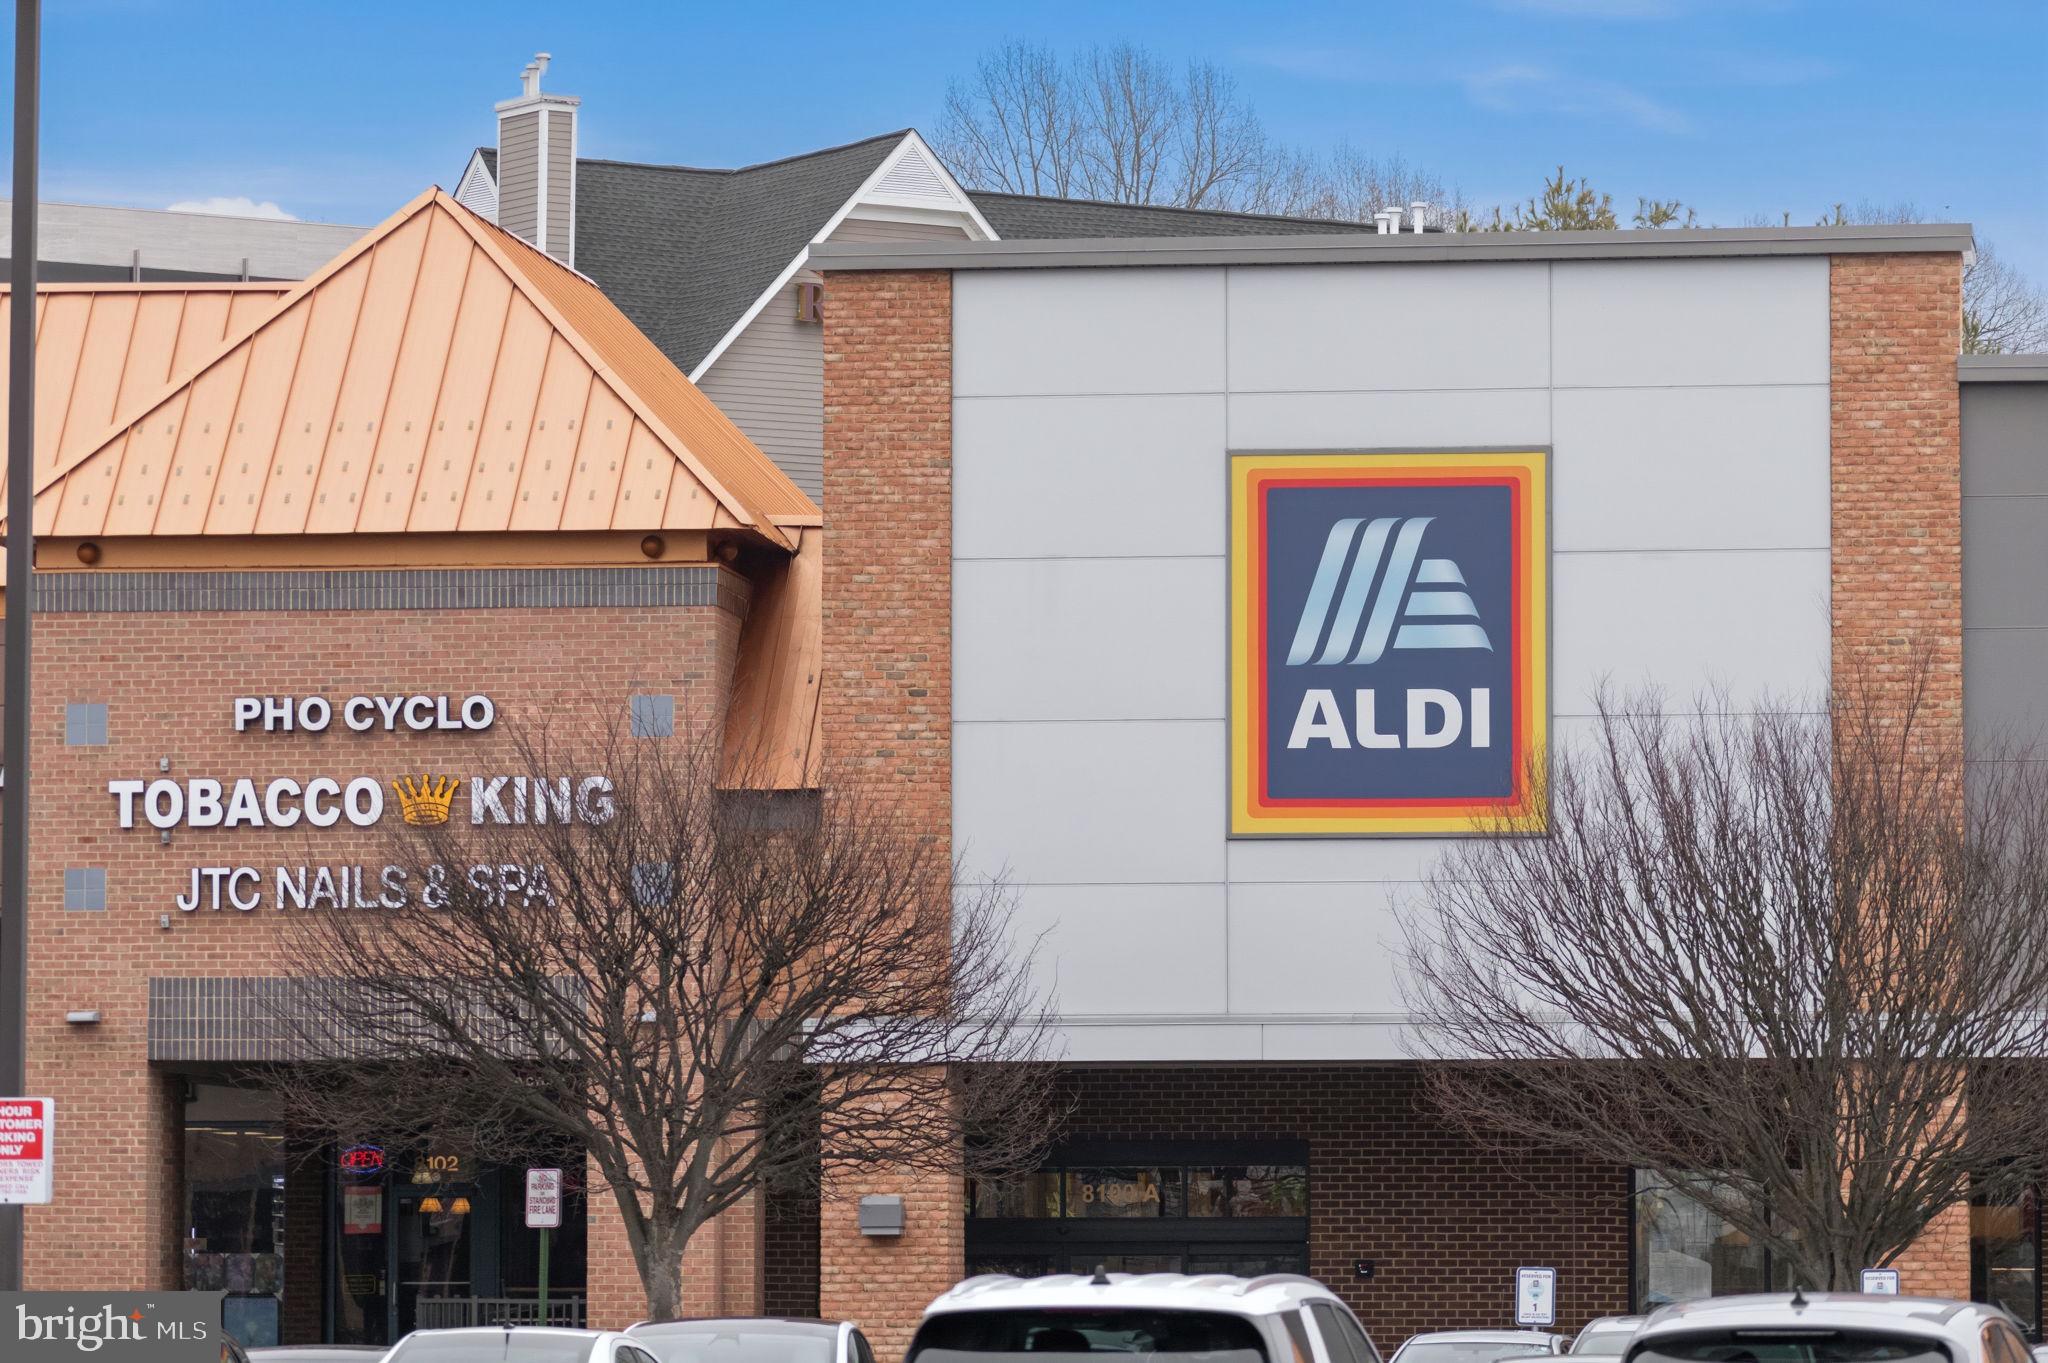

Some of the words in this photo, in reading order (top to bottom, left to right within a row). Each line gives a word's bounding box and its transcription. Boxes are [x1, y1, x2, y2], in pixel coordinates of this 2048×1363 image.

[234, 696, 332, 732] PHO
[344, 695, 495, 732] CYCLO
[1286, 687, 1490, 750] ALDI
[108, 777, 384, 829] TOBACCO
[471, 776, 614, 826] KING
[176, 867, 262, 911] JTC
[276, 865, 408, 910] NAILS
[467, 864, 556, 908] SPA
[340, 1150, 385, 1168] OPEN
[427, 1155, 459, 1172] 102
[529, 1206, 541, 1214] FIRE
[542, 1206, 556, 1214] LANE
